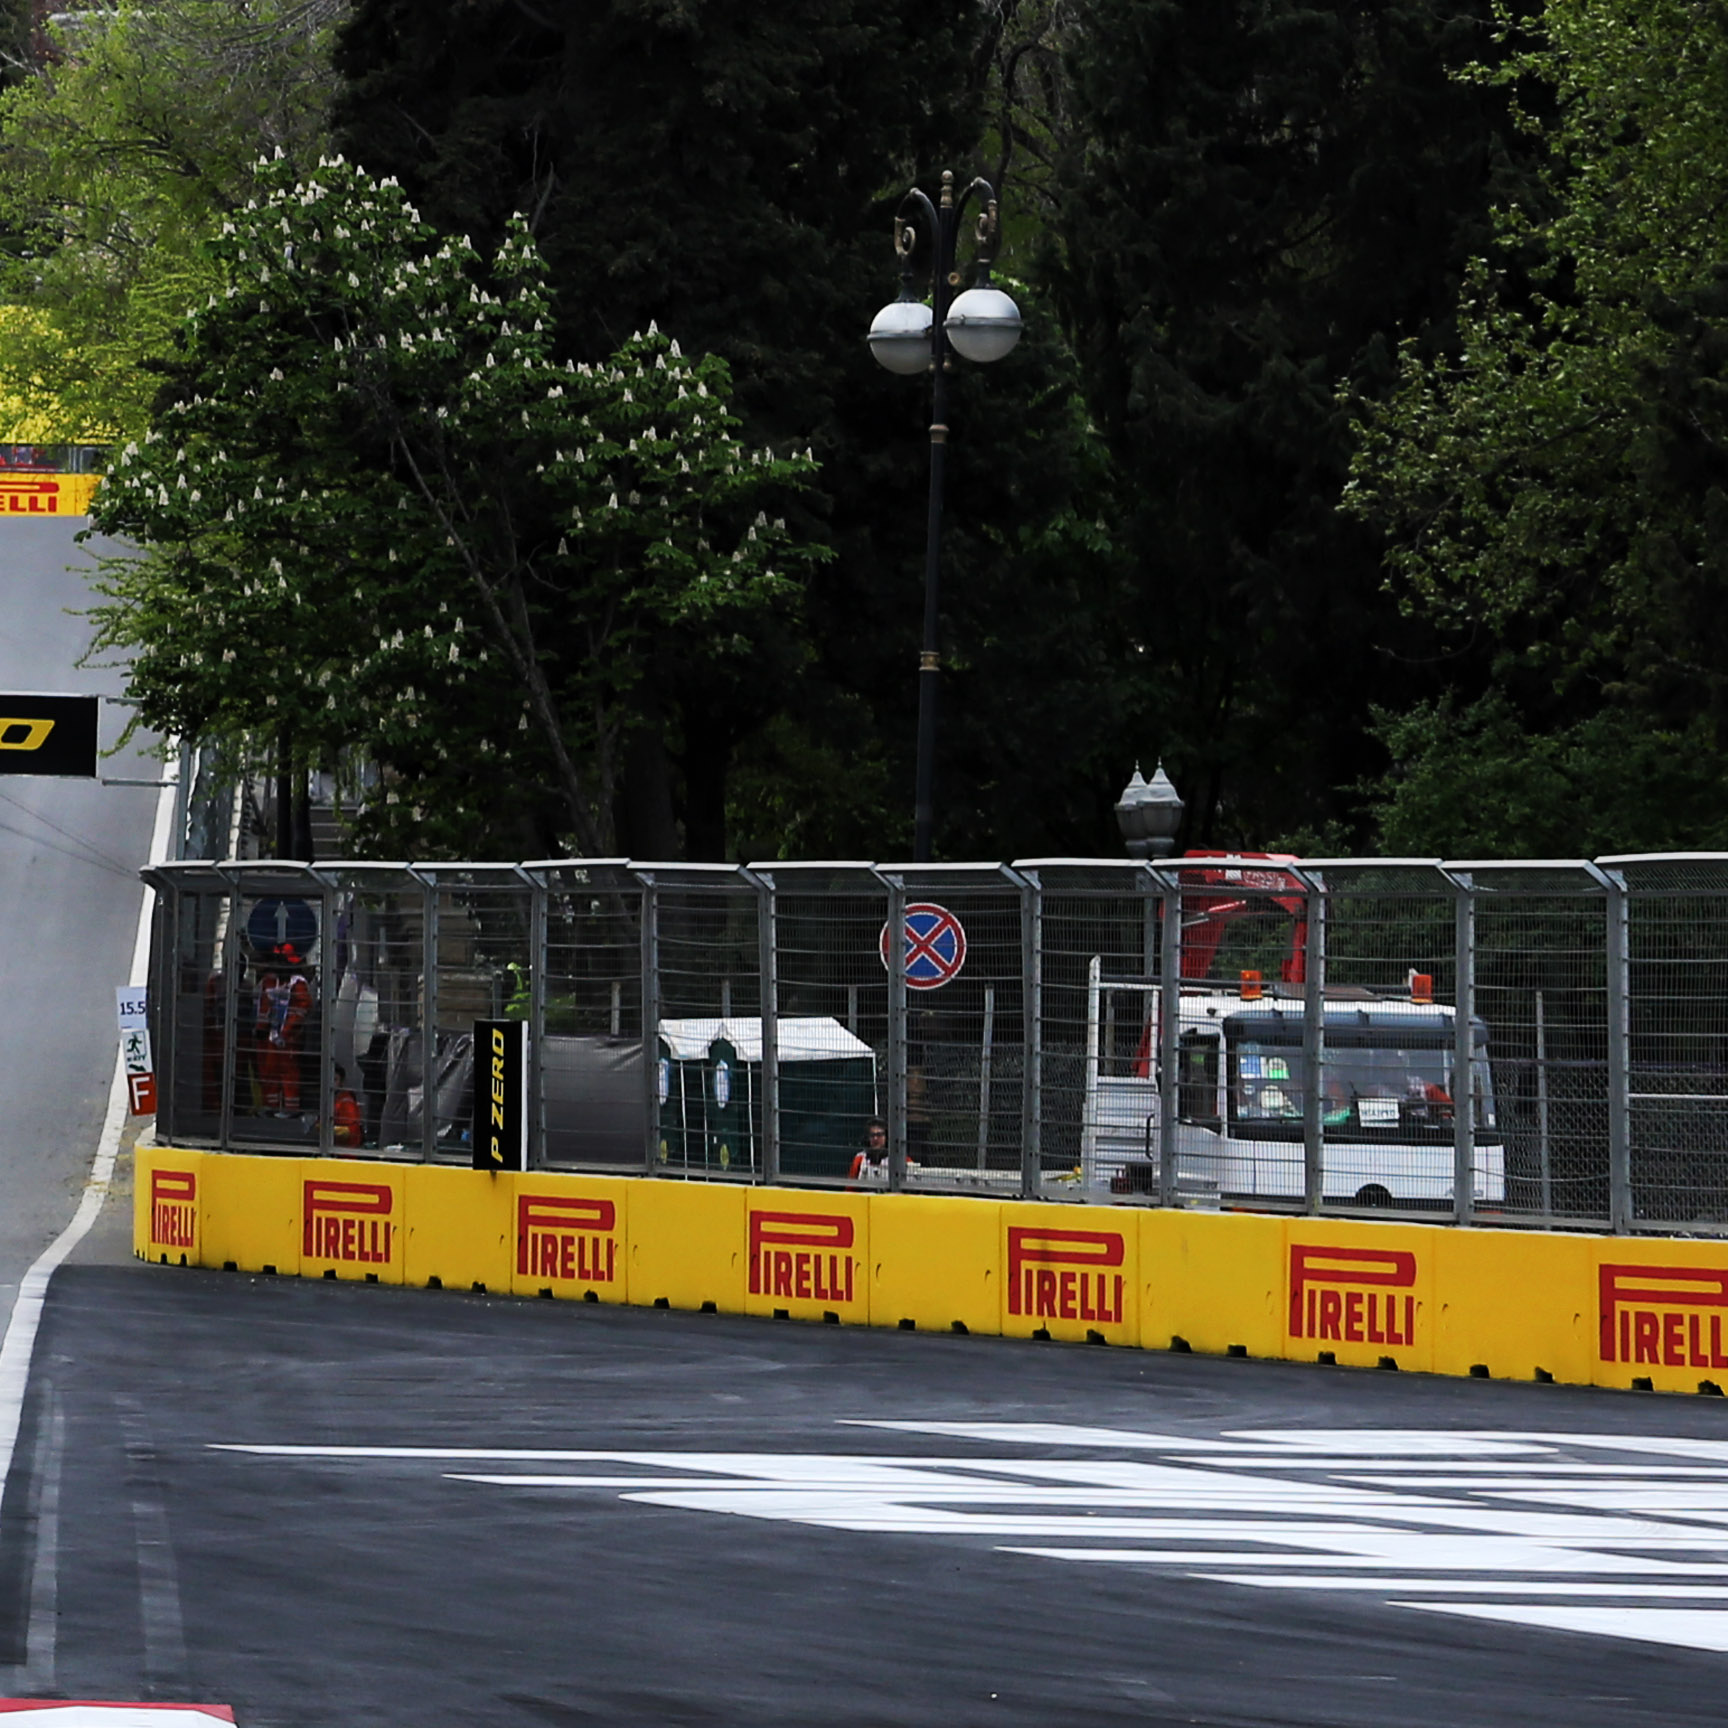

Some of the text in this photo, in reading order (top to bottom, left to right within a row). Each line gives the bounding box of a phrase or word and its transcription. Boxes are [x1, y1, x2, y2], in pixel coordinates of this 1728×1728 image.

[120, 1001, 146, 1015] 15.5
[131, 1076, 150, 1110] F
[491, 1028, 504, 1163] P ZERO
[151, 1170, 196, 1248] PIRELLI
[303, 1180, 392, 1263] PIRELLI
[517, 1194, 616, 1282] PIRELLI
[744, 1208, 854, 1302] PIRELLI
[1008, 1226, 1125, 1324] PIRELLI
[1289, 1244, 1422, 1347] PIRELLI
